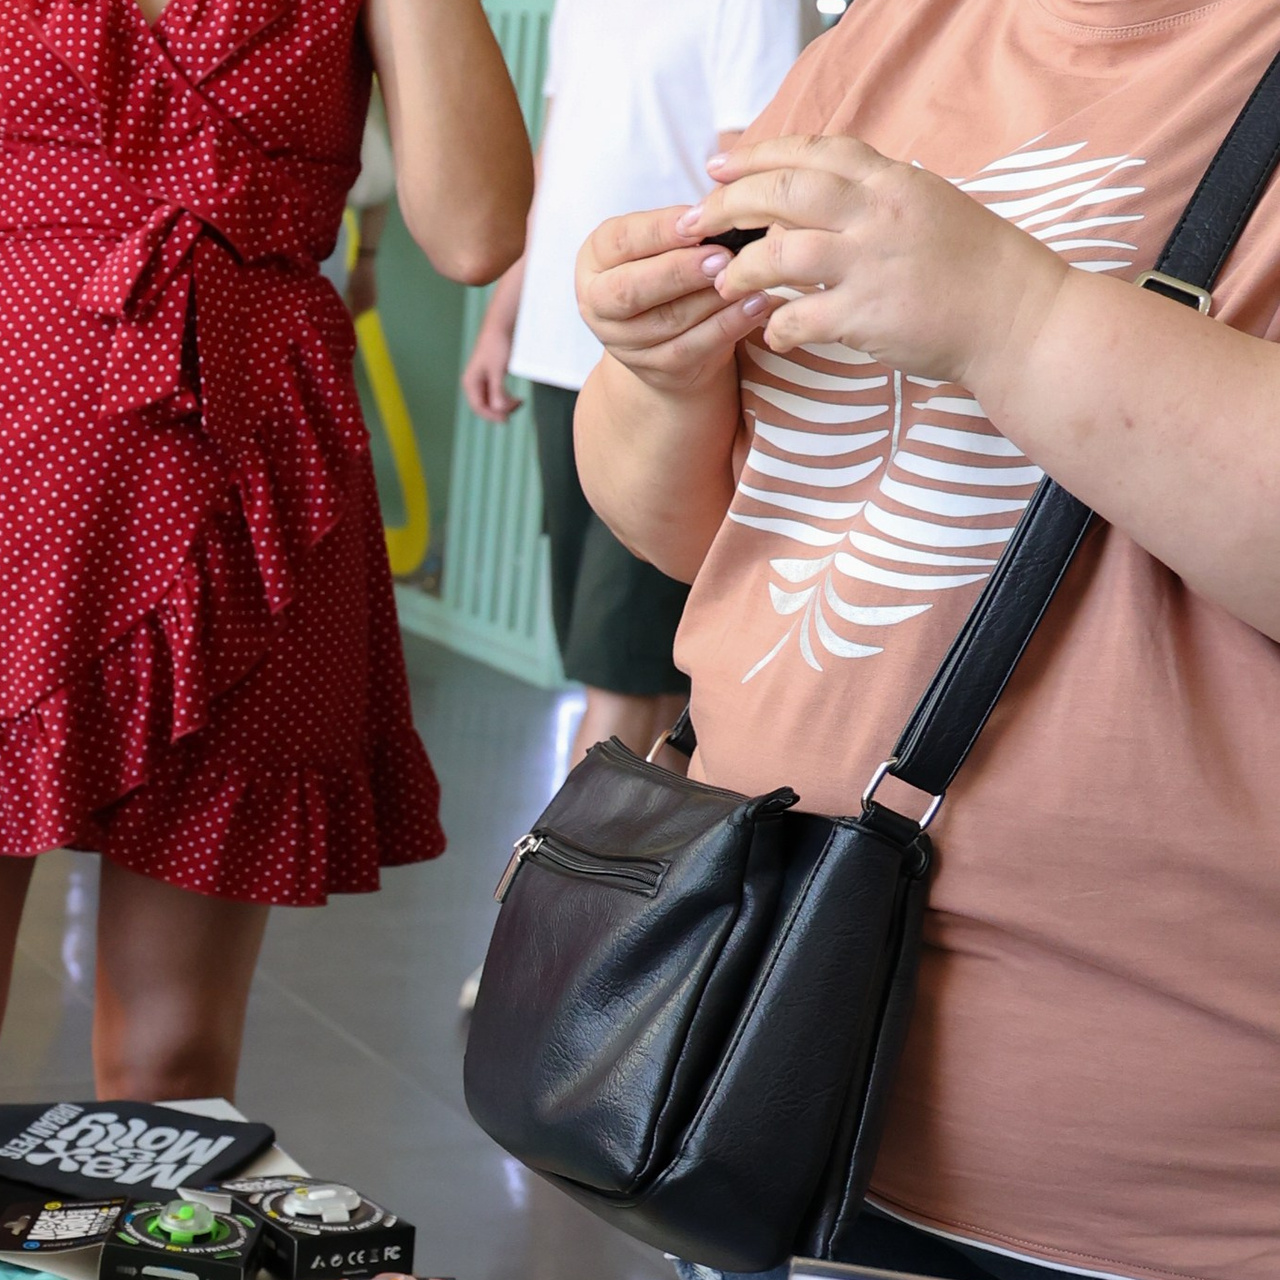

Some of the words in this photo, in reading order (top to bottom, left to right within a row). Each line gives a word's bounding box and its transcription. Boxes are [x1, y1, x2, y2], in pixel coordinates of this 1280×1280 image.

[26, 1102, 85, 1140] URBAN
[56, 1111, 236, 1166] Molly
[25, 1138, 204, 1190] Max
